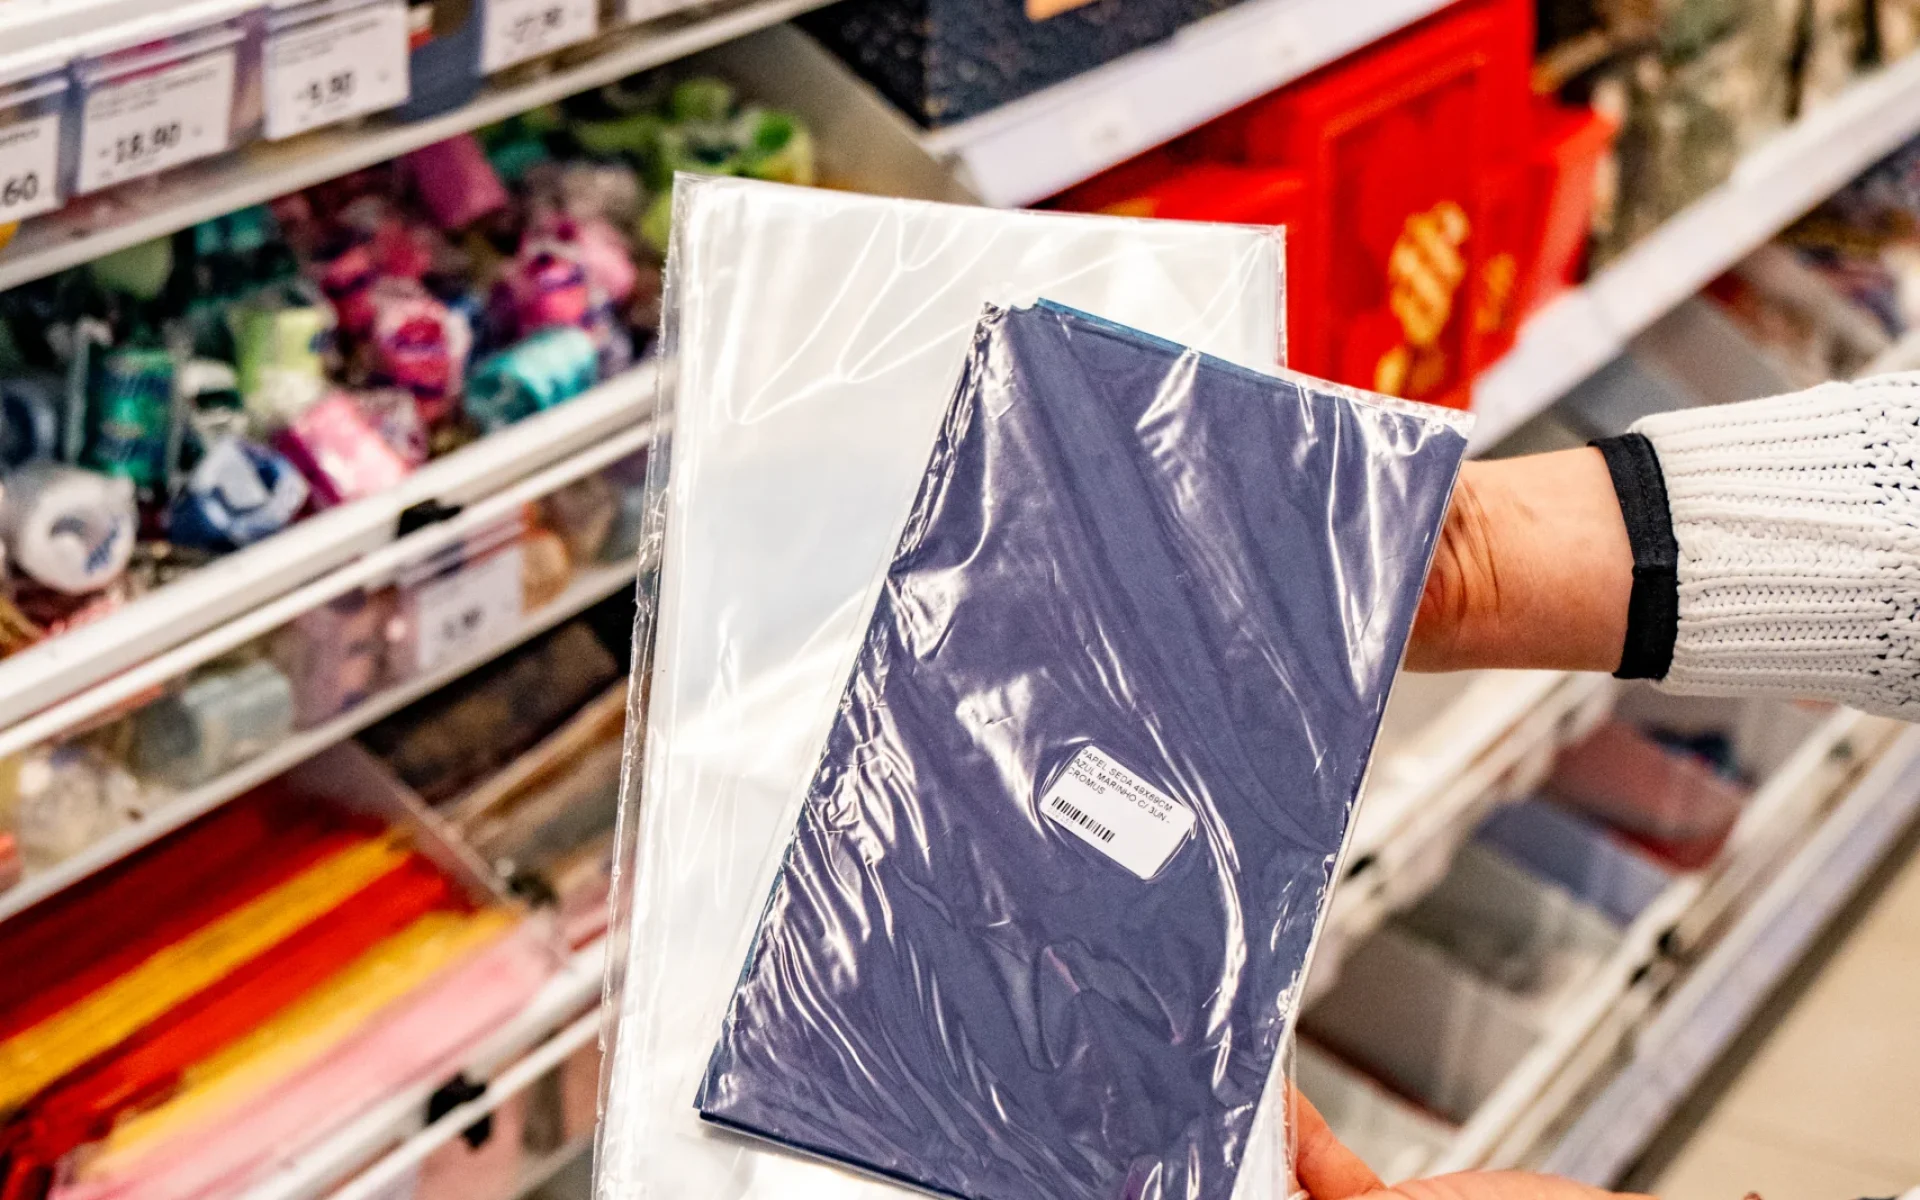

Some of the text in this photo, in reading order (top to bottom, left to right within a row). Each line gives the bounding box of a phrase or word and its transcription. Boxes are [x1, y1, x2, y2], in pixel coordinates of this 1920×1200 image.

[1067, 766, 1106, 794] CROMUS
[1082, 749, 1108, 771] PAPEL
[1109, 768, 1133, 786] SEDA
[1074, 758, 1095, 775] AZUL
[1097, 772, 1137, 802] MARINHO
[1137, 799, 1149, 810] C/
[1148, 806, 1167, 821] 3UN
